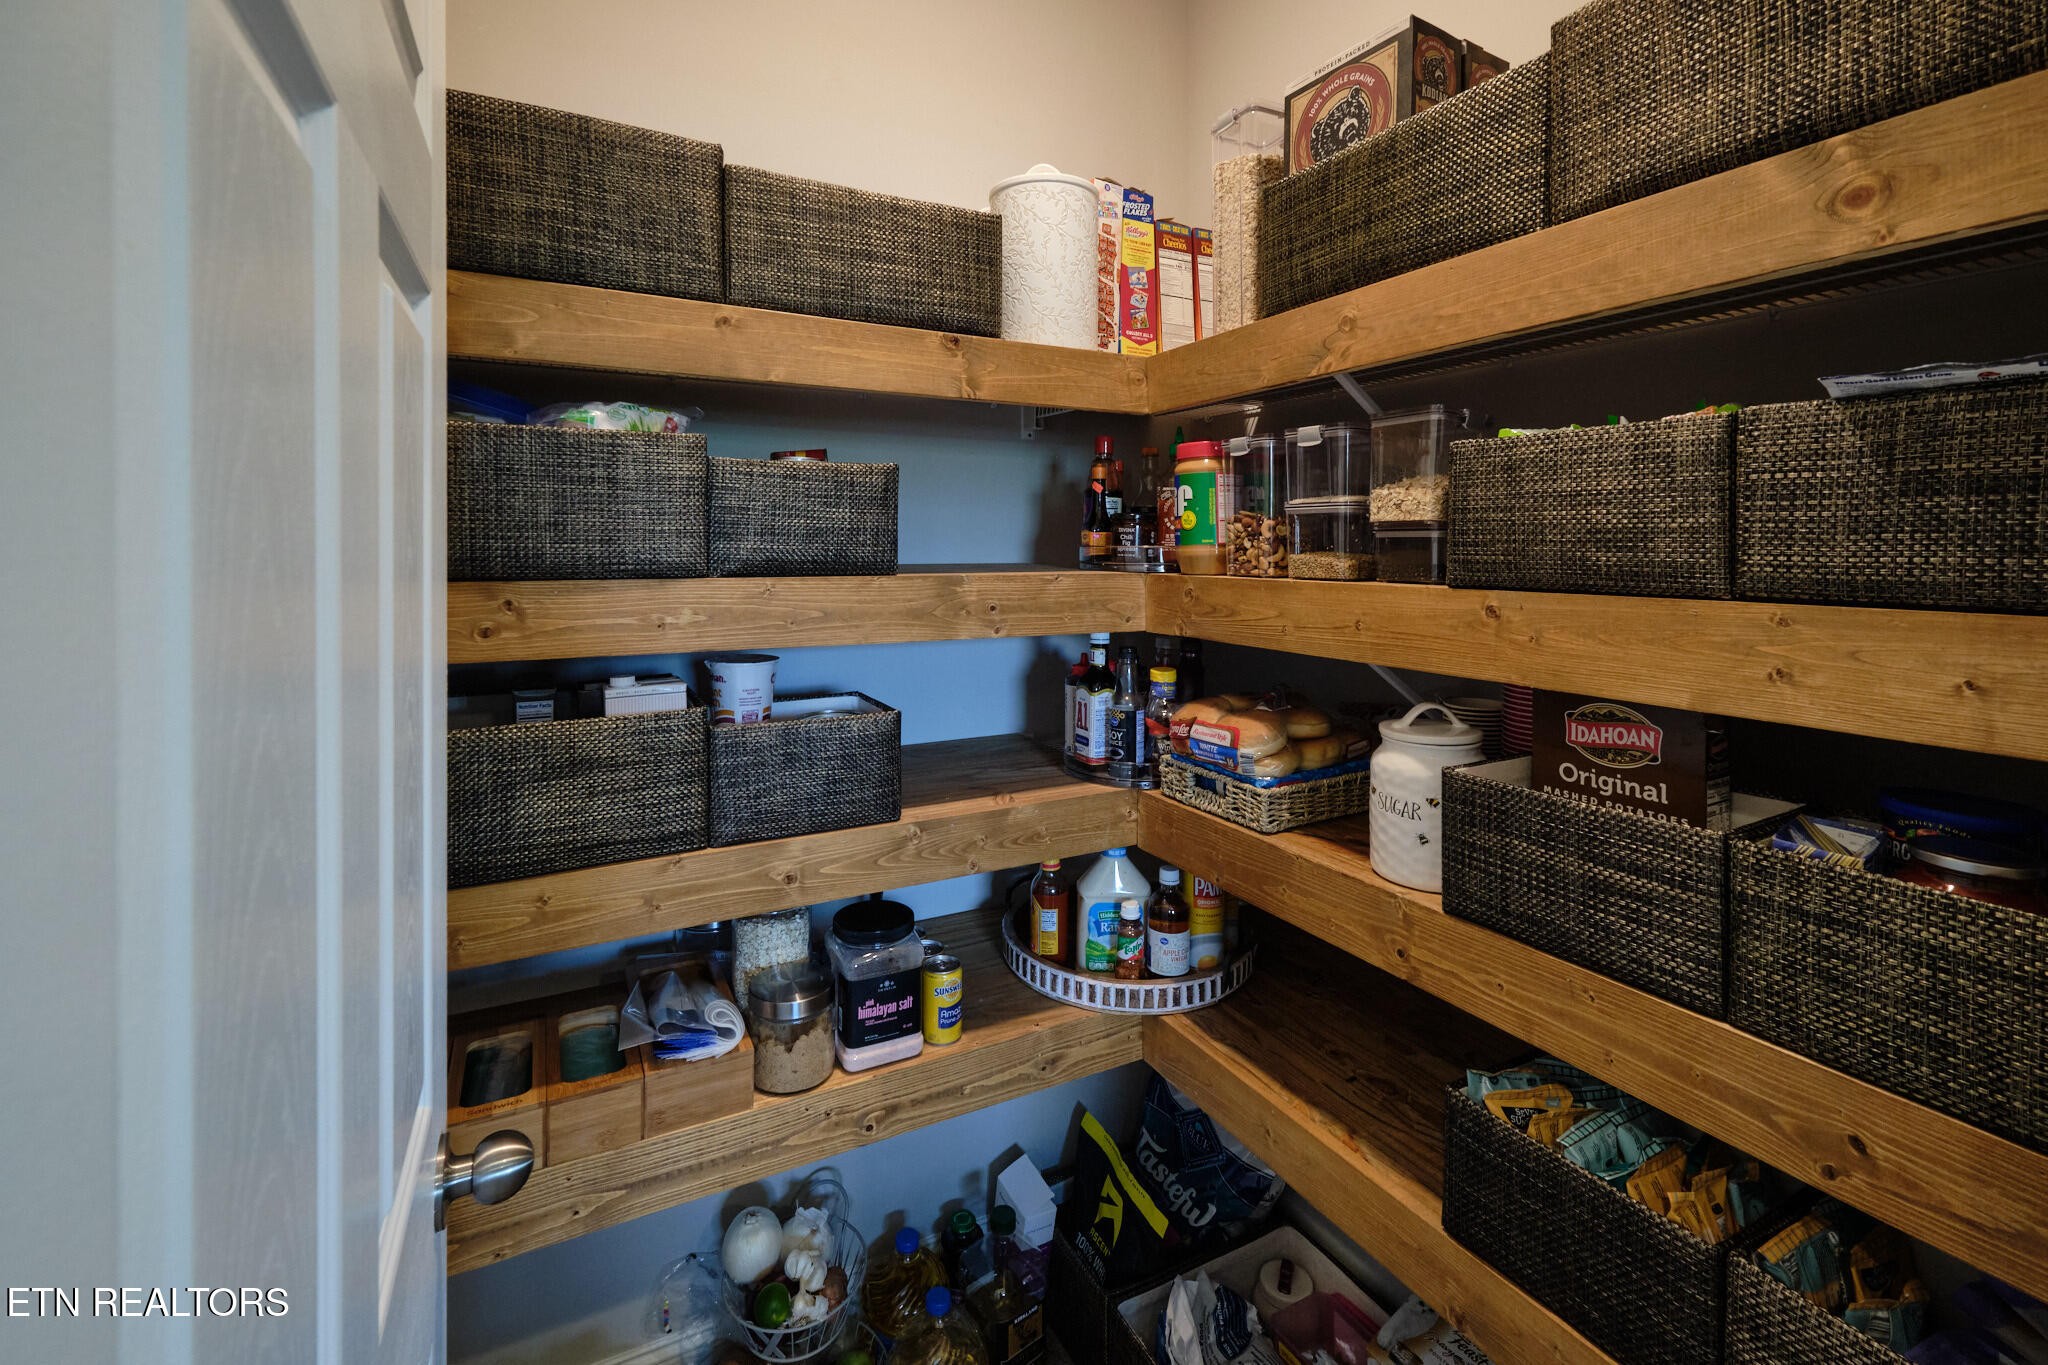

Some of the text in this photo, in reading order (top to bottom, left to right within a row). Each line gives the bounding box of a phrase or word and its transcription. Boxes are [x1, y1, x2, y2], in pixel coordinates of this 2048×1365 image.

[1308, 72, 1376, 117] 100% WHOLE GRAINS
[1121, 201, 1151, 211] FROSTED
[1122, 208, 1148, 217] FLAKES
[1163, 237, 1187, 251] Cheerios
[1199, 742, 1218, 753] WHITE
[1570, 722, 1656, 749] IDAHOAN
[1559, 762, 1669, 804] Original
[1378, 791, 1422, 822] SUGAR
[1543, 785, 1599, 806] MASHED
[1605, 800, 1690, 829] POTATOES
[858, 995, 913, 1020] himalayan salt
[466, 1099, 523, 1117] Sandwich
